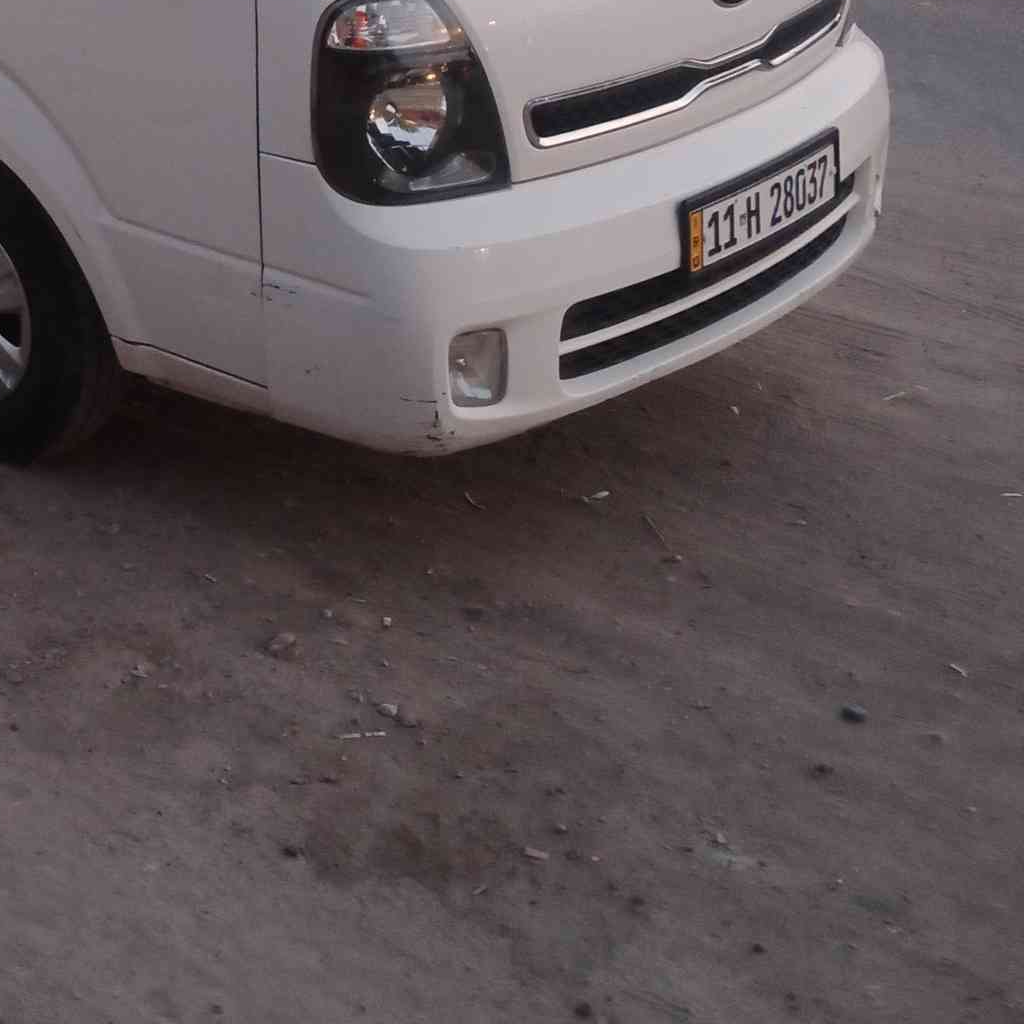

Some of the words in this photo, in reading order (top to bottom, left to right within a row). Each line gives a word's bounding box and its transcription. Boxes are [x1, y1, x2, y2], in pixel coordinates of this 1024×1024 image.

[707, 203, 738, 257] 11
[746, 191, 761, 239] H
[770, 154, 828, 227] 28037
